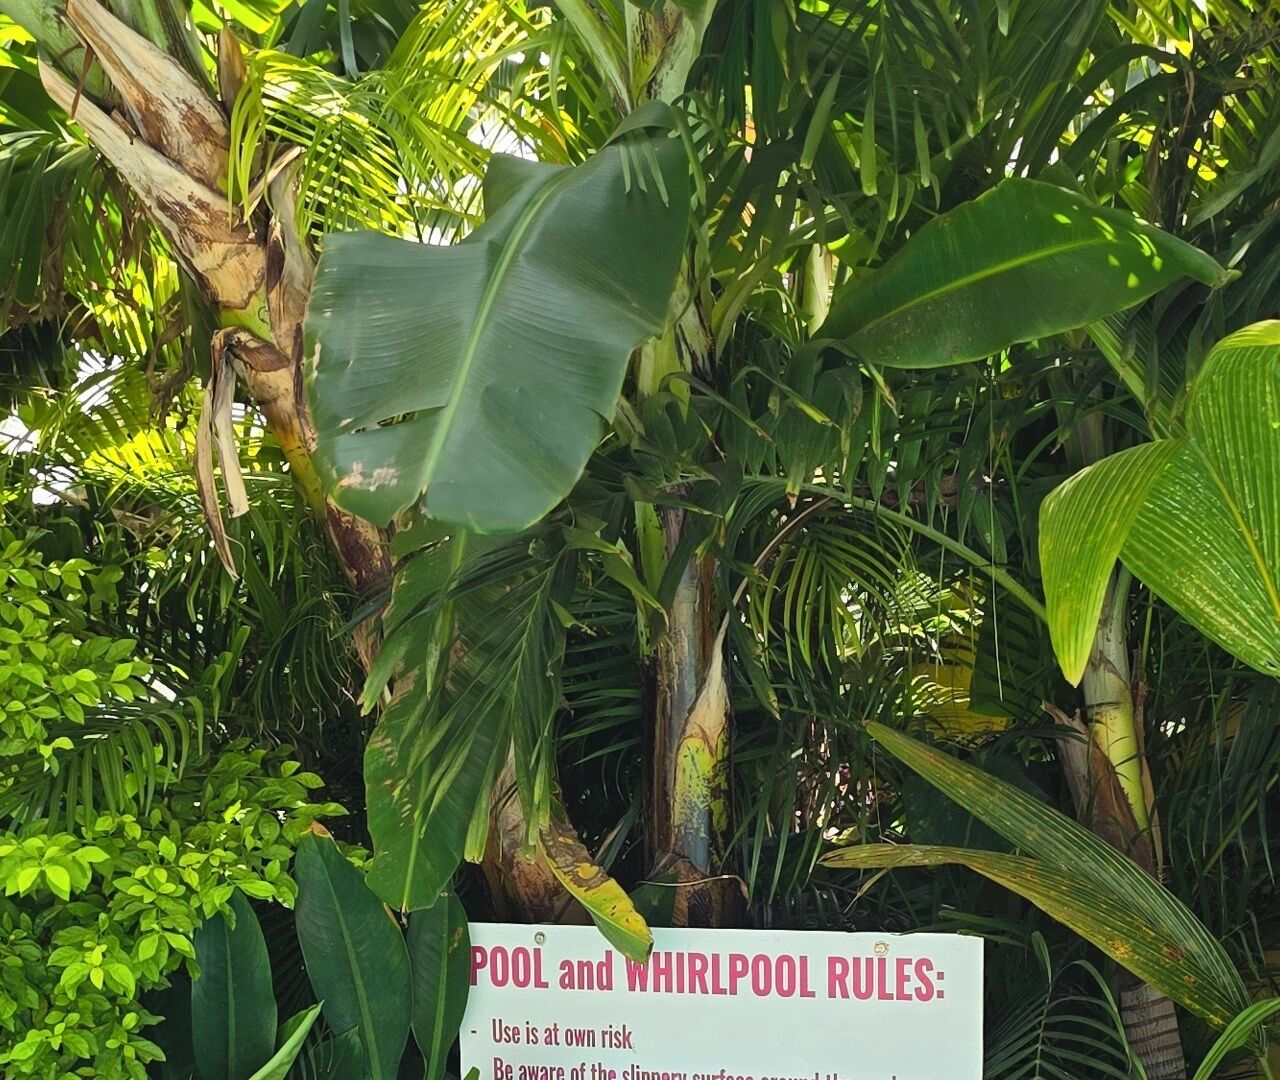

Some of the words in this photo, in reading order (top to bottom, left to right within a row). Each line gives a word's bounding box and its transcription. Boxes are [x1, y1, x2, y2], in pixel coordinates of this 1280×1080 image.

[470, 944, 549, 989] POOL
[559, 950, 613, 991] and
[625, 950, 816, 998] WHIRLPOOL
[826, 955, 945, 1002] RULES:
[492, 1018, 520, 1044] Use
[526, 1021, 539, 1045] is
[544, 1022, 560, 1046] at
[565, 1027, 596, 1048] own
[601, 1024, 633, 1050] risk
